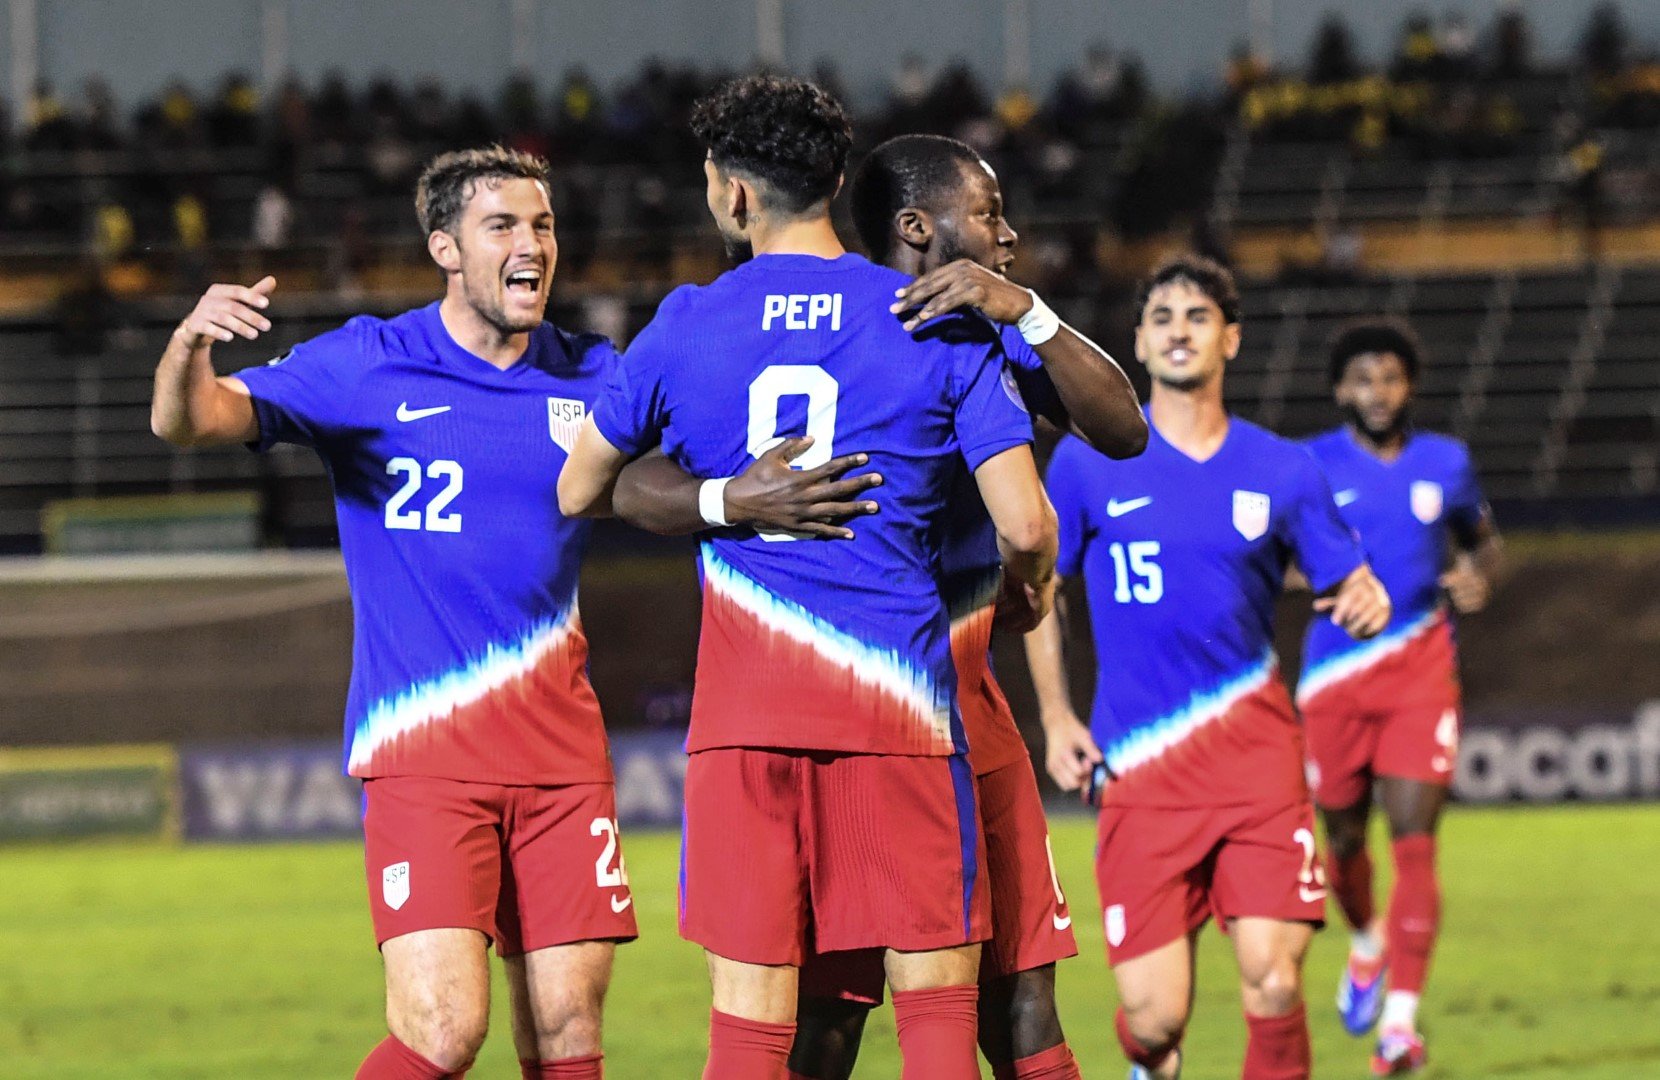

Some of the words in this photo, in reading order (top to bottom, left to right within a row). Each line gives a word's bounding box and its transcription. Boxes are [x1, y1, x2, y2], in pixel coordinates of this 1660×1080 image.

[762, 293, 843, 331] PEPI
[551, 402, 581, 422] USA
[747, 365, 839, 542] 9
[384, 456, 464, 533] 22
[1109, 541, 1164, 604] 15
